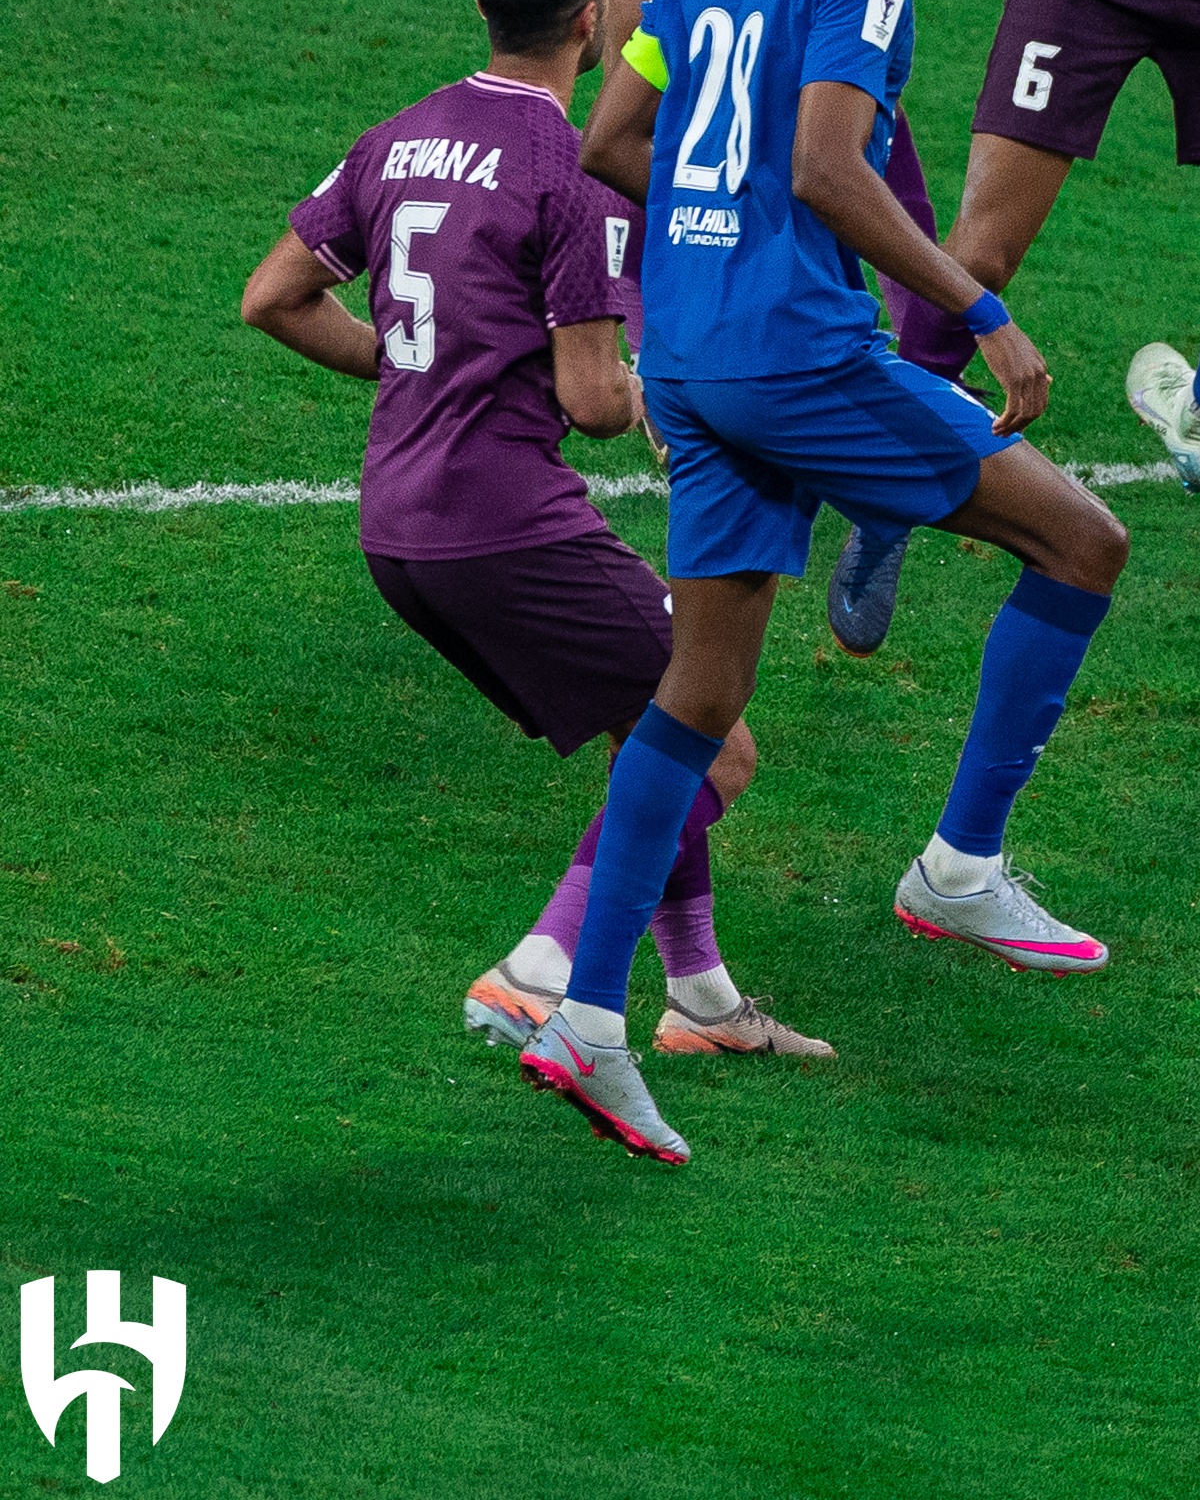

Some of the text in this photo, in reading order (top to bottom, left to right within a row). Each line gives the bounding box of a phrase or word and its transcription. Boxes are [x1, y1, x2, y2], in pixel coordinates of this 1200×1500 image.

[672, 6, 765, 195] 28
[1012, 40, 1062, 112] 6
[384, 200, 452, 373] 5
